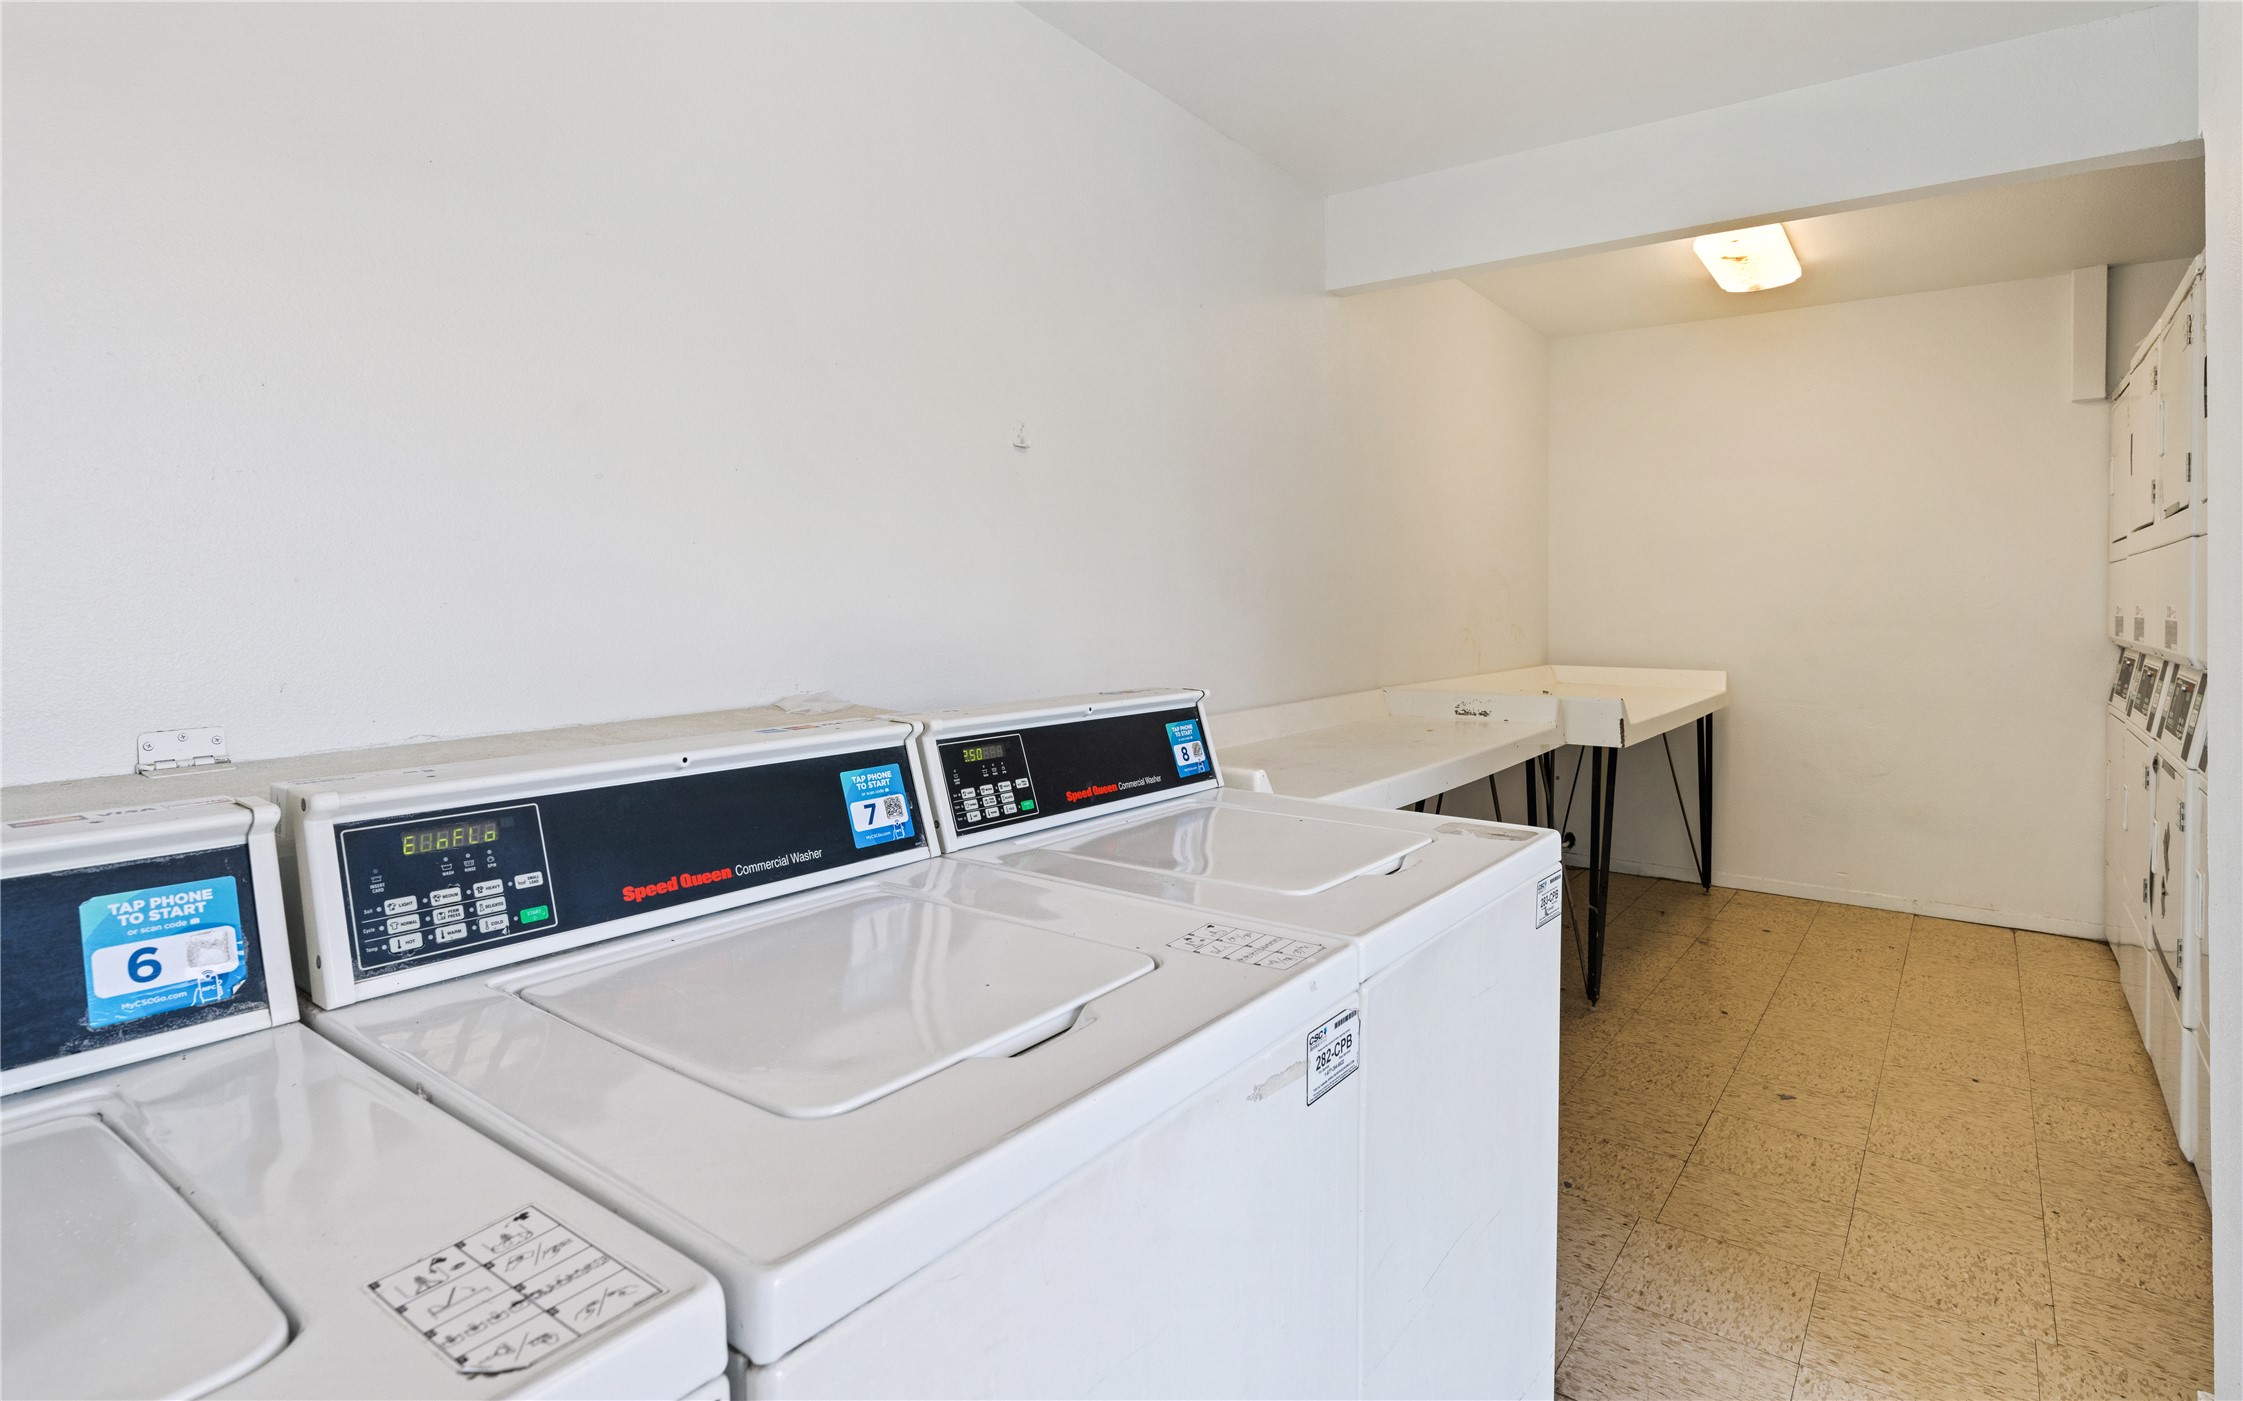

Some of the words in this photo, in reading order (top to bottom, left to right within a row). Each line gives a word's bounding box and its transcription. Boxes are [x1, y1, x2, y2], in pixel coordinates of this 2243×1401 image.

[1181, 746, 1190, 761] 8
[851, 775, 866, 784] TAP
[867, 770, 892, 781] PHONE
[868, 778, 890, 789] START
[1065, 787, 1093, 803] Speed
[1092, 783, 1118, 796] Queen
[1118, 777, 1146, 791] Commercial
[1145, 775, 1161, 785] Washer
[863, 803, 876, 826] 7
[622, 876, 679, 902] Speed
[679, 867, 733, 889] Queen
[735, 855, 790, 877] Commercial
[790, 848, 823, 864] Washer
[107, 899, 146, 916] TAP
[149, 888, 214, 909] PHONE
[117, 912, 144, 926] TO
[148, 901, 207, 921] START
[527, 908, 541, 916] START
[127, 928, 138, 936] or
[140, 924, 162, 934] scan
[164, 919, 187, 930] code
[363, 927, 375, 935] Cycle
[400, 919, 418, 927] NORMAL
[447, 928, 462, 936] WARM
[490, 919, 504, 927] COLD
[128, 946, 162, 984] 6
[121, 991, 187, 1010] MyCSCGo.com
[1309, 1030, 1324, 1046] CSC
[1315, 1033, 1353, 1072] 282-CPB
